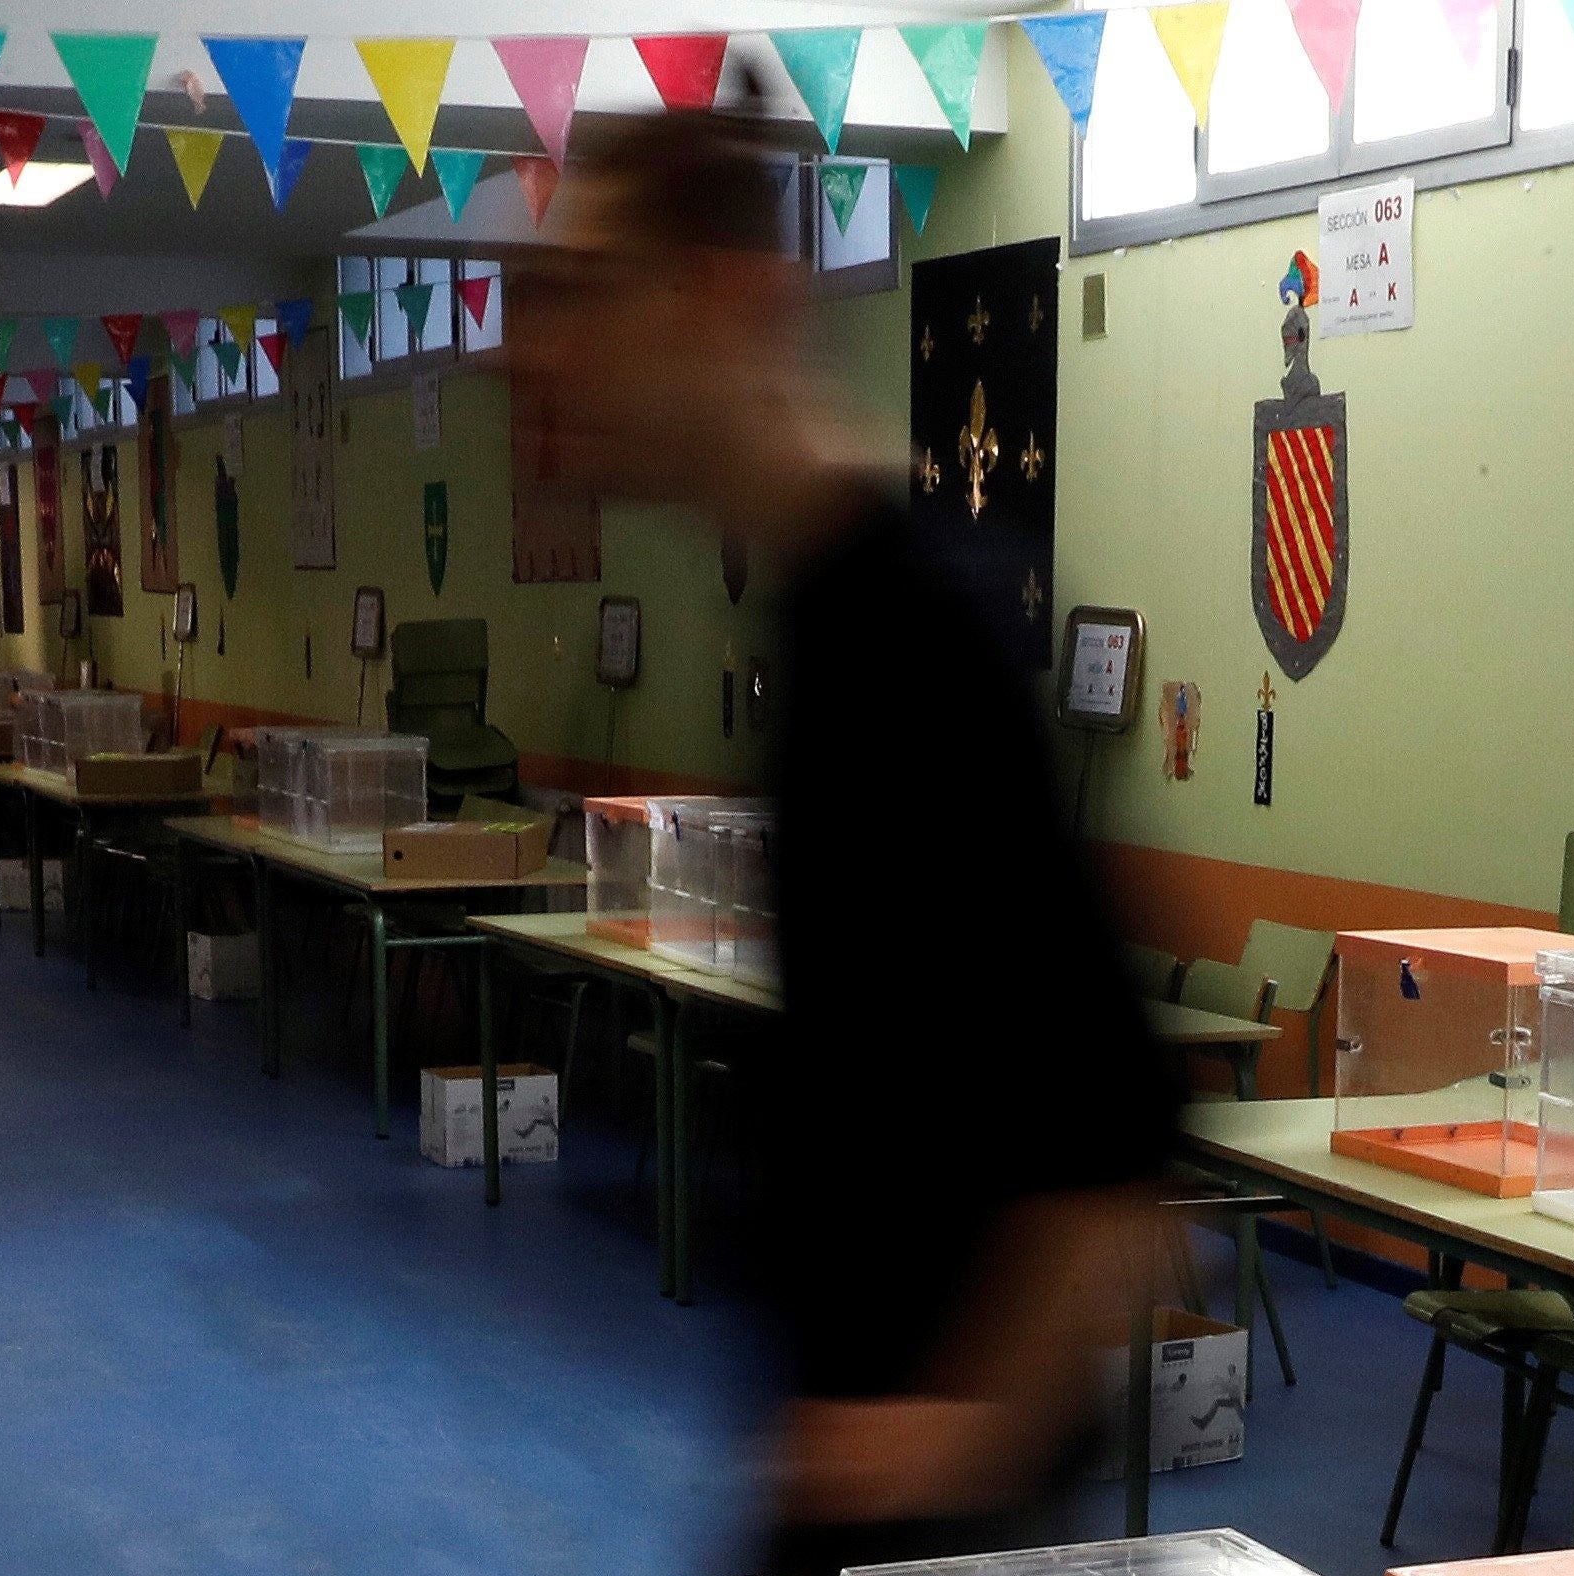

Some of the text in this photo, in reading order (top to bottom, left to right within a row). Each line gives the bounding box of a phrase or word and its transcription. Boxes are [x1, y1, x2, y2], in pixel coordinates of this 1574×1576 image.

[1374, 195, 1403, 223] 063
[1345, 242, 1390, 271] MESA A
[1349, 288, 1359, 308] A
[1387, 282, 1398, 301] K
